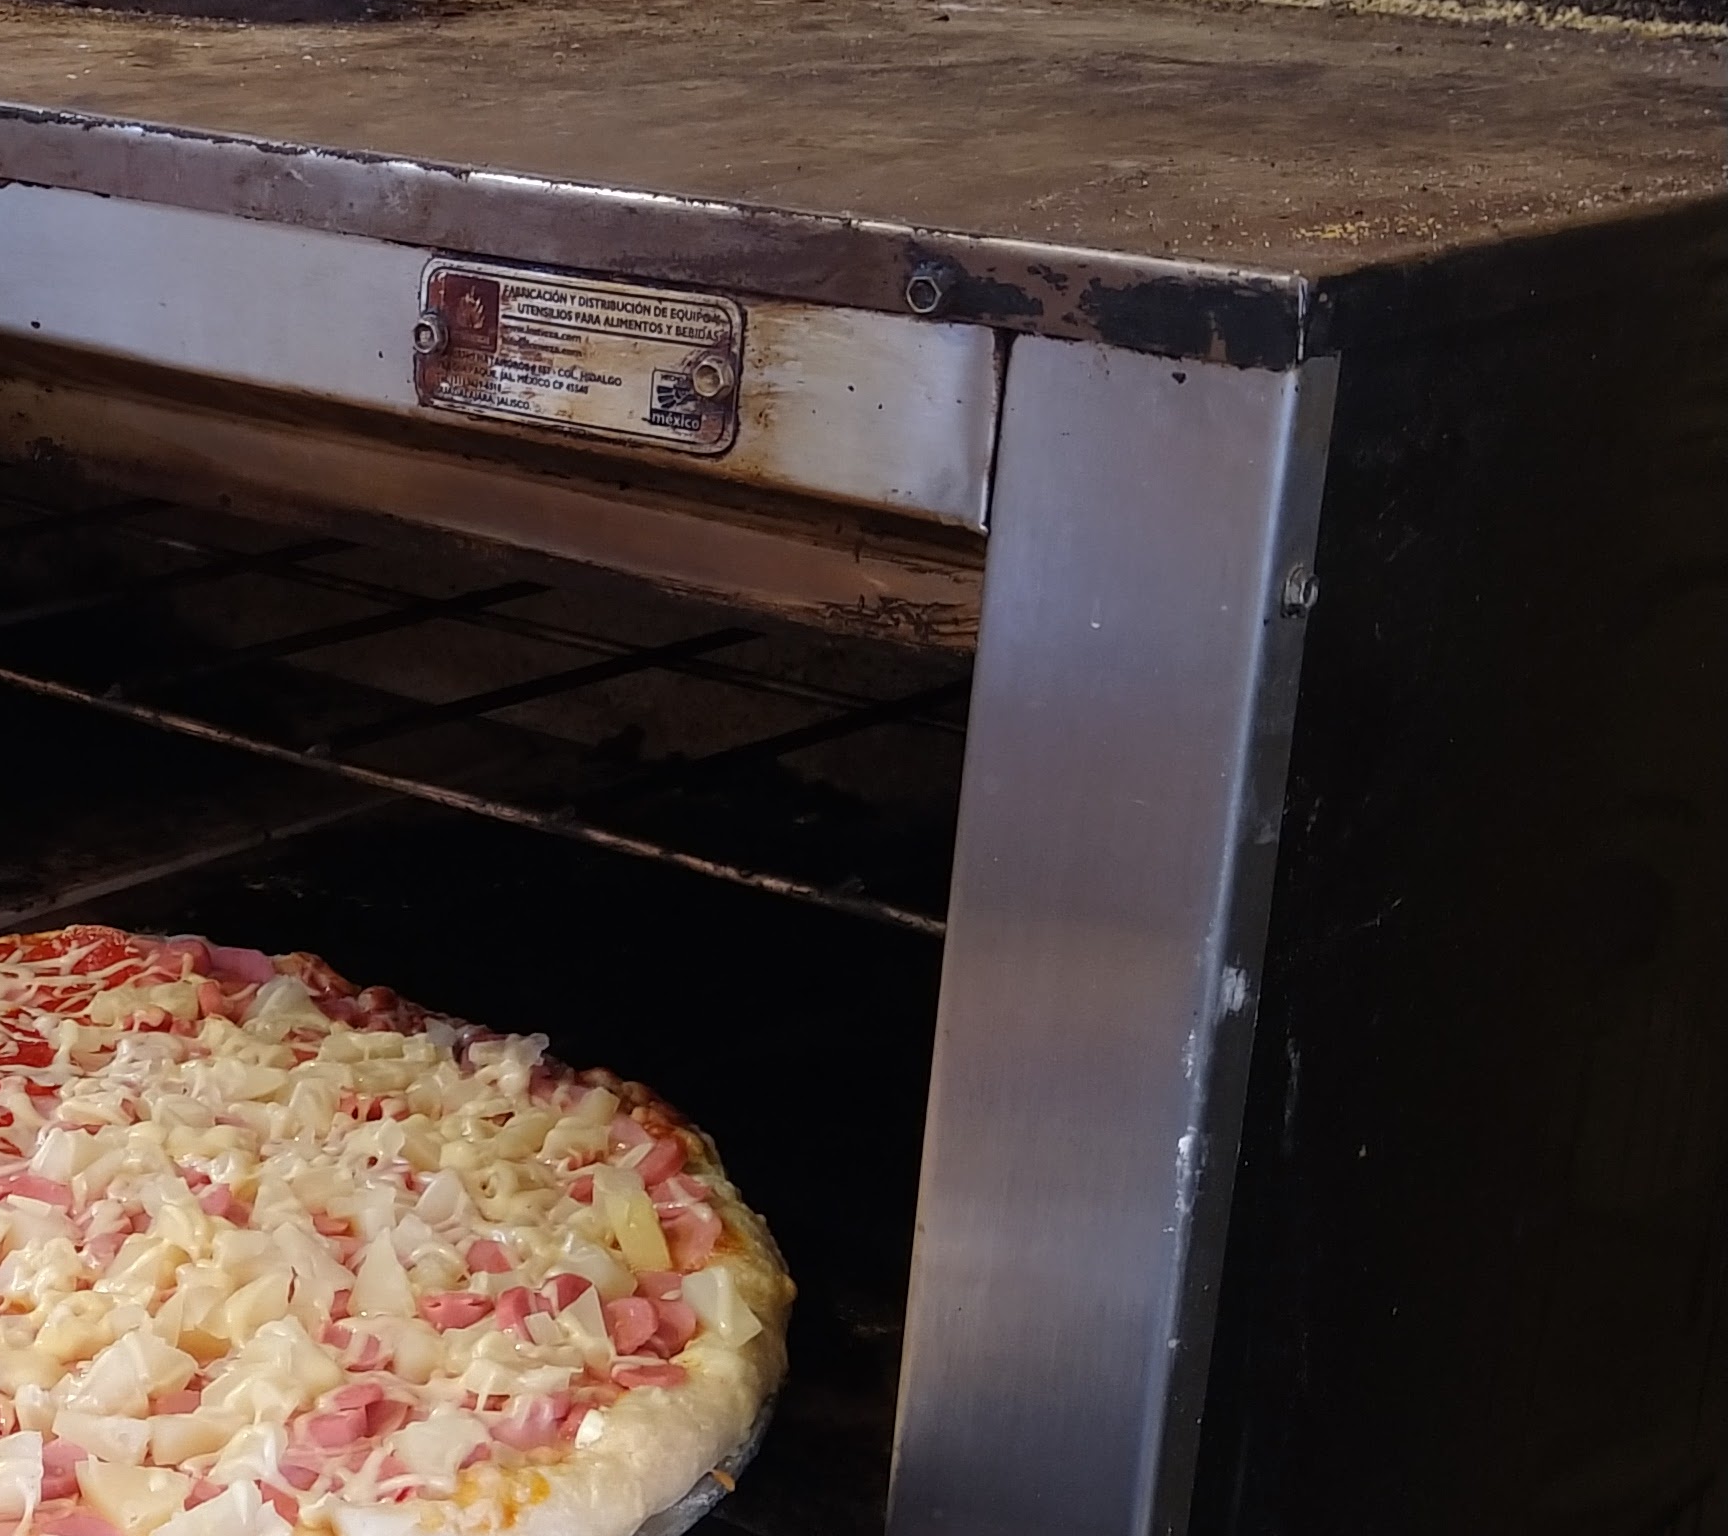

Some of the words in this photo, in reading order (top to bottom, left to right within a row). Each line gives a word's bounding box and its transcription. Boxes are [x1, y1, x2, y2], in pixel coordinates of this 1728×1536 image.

[569, 295, 577, 306] Y
[578, 296, 652, 317] DISTRIBUCIÓN
[654, 305, 668, 318] DE
[517, 303, 573, 321] UTENSILIOS
[574, 313, 601, 327] PARA
[603, 316, 663, 335] ALIMENTOS
[666, 325, 673, 336] Y
[675, 325, 719, 342] BEBIDAS
[652, 412, 700, 430] méxico
